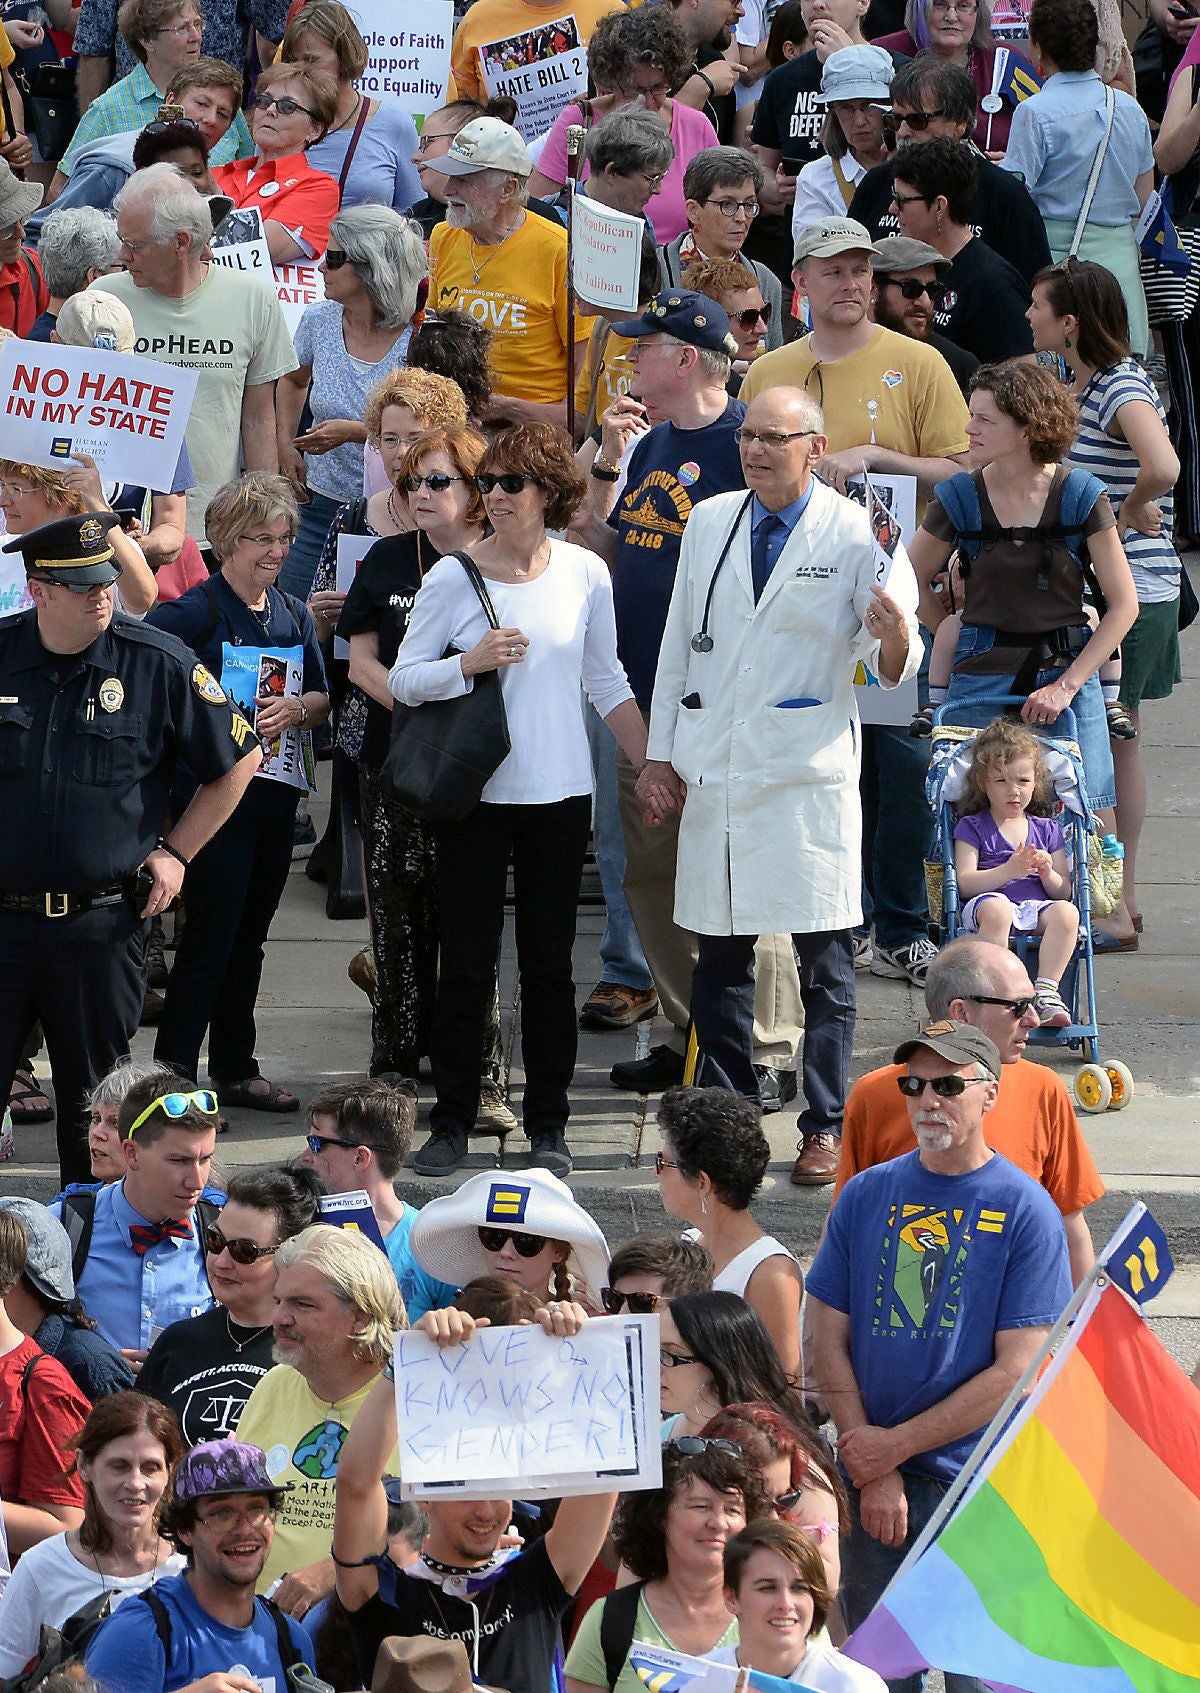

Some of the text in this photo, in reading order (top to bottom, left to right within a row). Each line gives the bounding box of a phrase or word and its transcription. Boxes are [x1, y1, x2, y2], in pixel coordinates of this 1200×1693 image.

[390, 32, 445, 50] of Faith
[368, 57, 420, 72] upport
[383, 78, 443, 98] Equality
[496, 58, 583, 98] HATE BILL 2
[584, 216, 634, 239] Republican
[251, 250, 262, 268] 2
[586, 272, 622, 294] Taliban
[458, 296, 527, 328] LOVE
[134, 334, 234, 354] OPHEAD
[12, 364, 174, 416] NO HATE
[6, 396, 168, 440] IN MY STATE
[76, 438, 108, 447] HUMAN
[625, 530, 664, 550] CA-148
[876, 562, 884, 582] 2
[293, 670, 302, 682] 2
[283, 730, 296, 774] HATE
[328, 1198, 368, 1208] www.hrc.org
[872, 1328, 954, 1339] Eno River
[400, 1330, 530, 1375] LOVE
[404, 1370, 628, 1417] KNOWS NO
[406, 1409, 628, 1464] GENDER!
[287, 1496, 310, 1506] Most
[282, 1516, 313, 1528] Except
[294, 1507, 310, 1517] the
